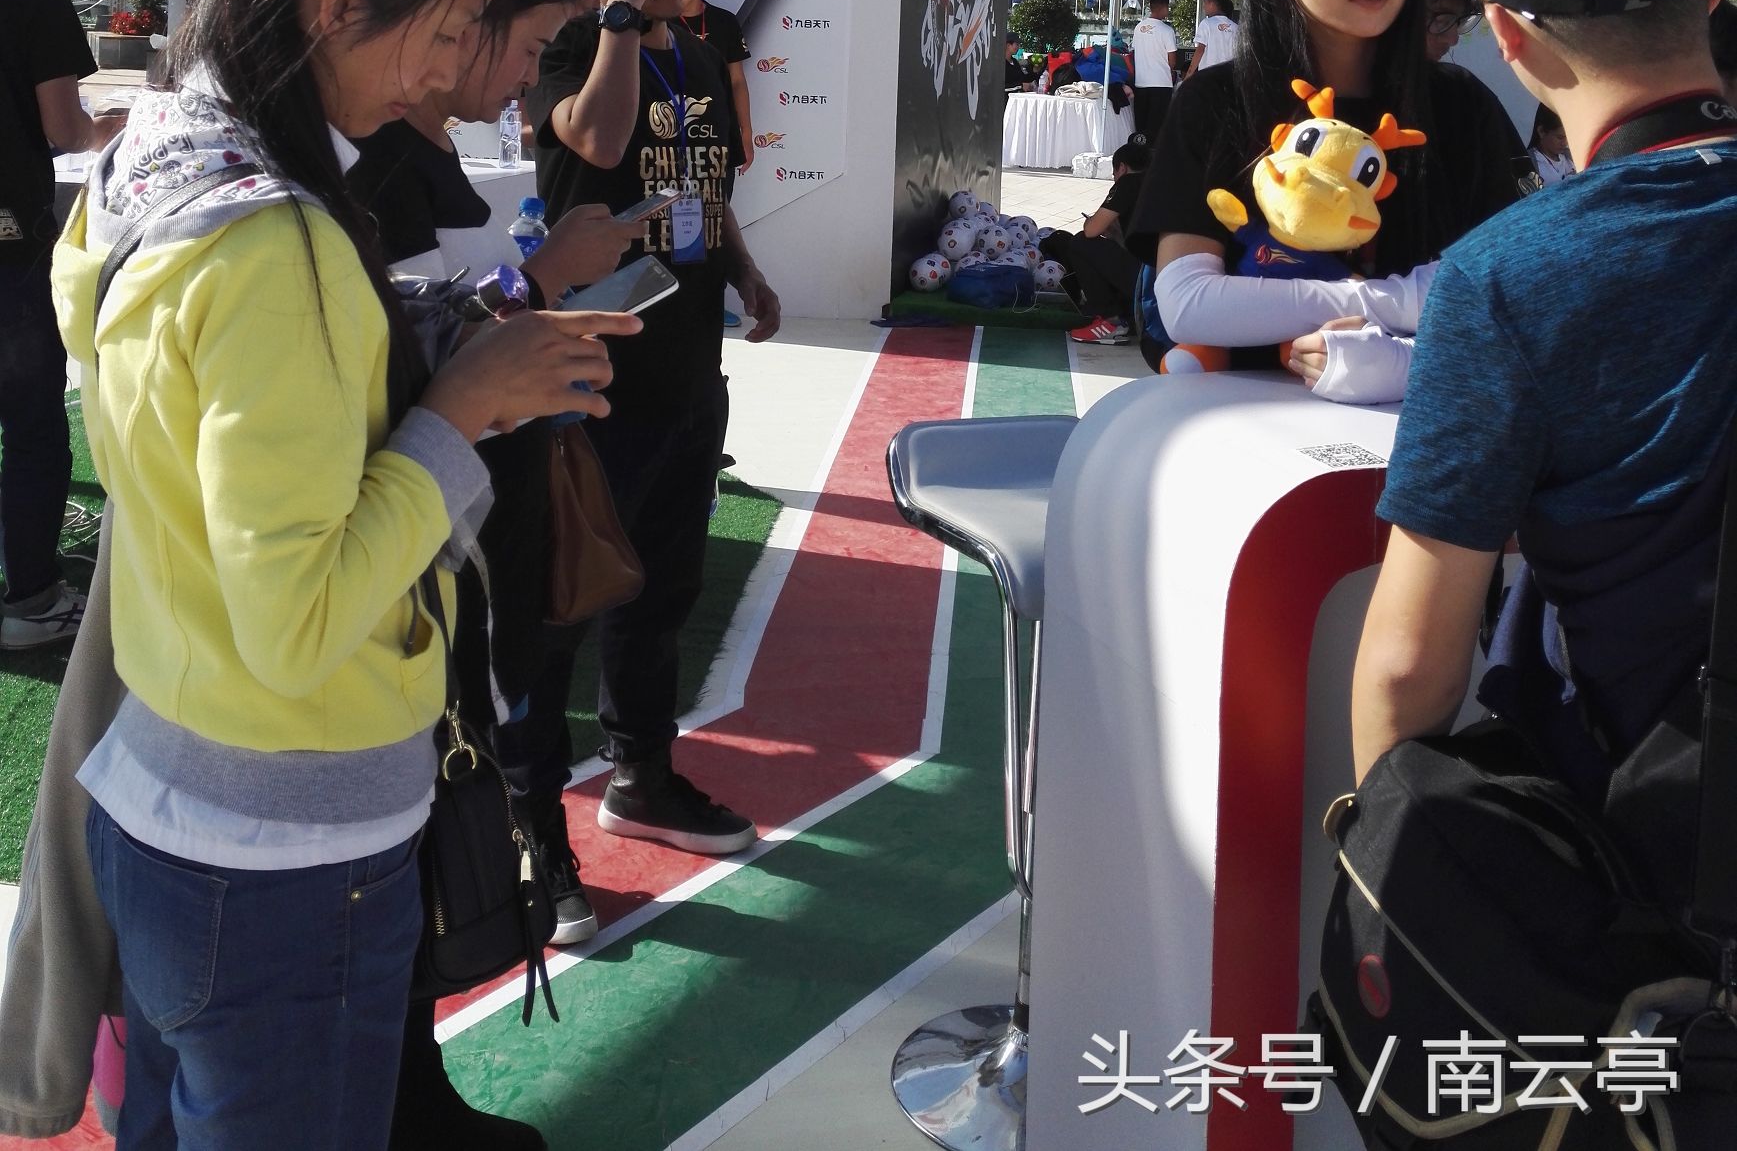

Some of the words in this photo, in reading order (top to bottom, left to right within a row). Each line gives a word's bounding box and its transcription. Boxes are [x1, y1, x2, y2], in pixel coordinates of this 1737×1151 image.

[795, 19, 831, 29] 九合天下
[792, 95, 828, 105] 九合天下
[688, 124, 718, 139] CSL
[789, 170, 825, 181] 九合天下
[644, 217, 723, 253] LEUE
